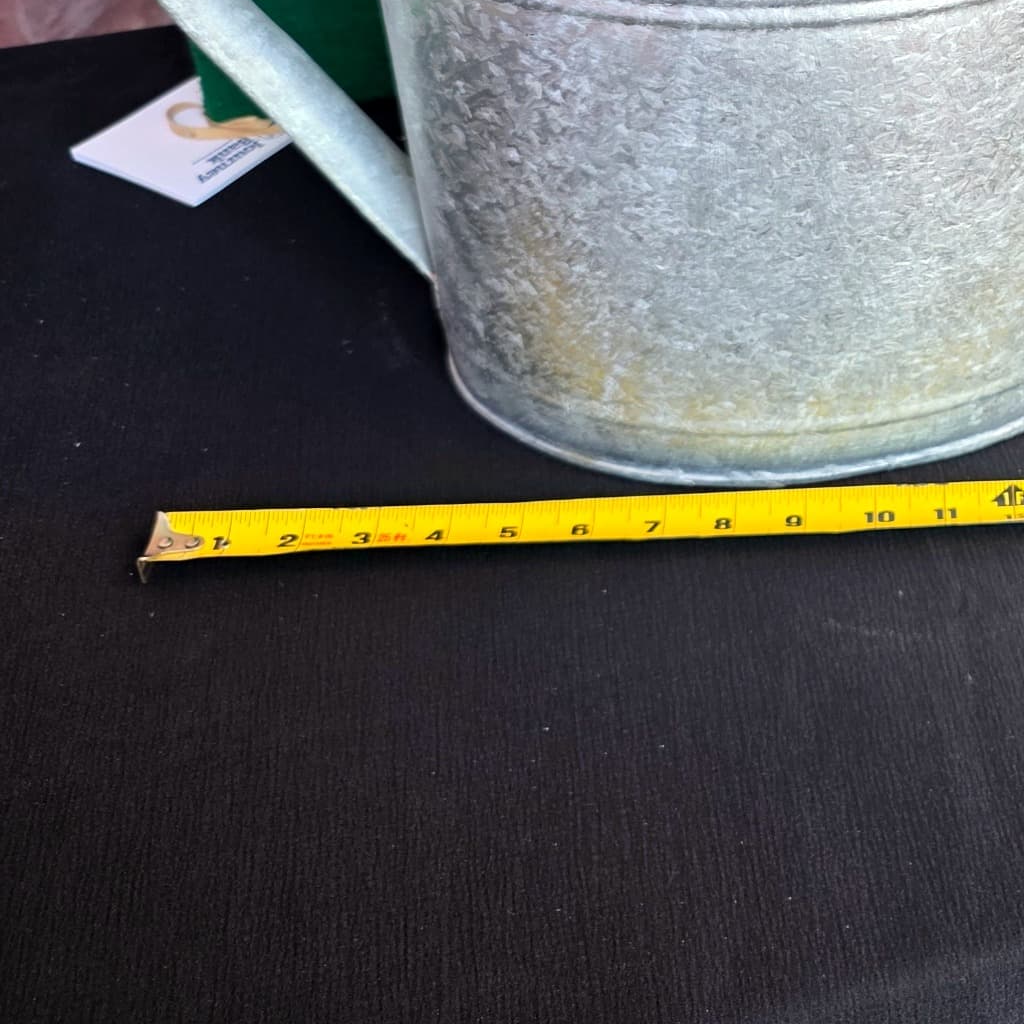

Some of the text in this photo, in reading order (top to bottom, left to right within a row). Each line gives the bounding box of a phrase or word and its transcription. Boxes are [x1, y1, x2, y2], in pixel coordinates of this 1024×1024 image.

[277, 534, 299, 547] 2
[352, 532, 371, 544] 3
[425, 529, 445, 541] 4
[499, 526, 518, 538] 5
[571, 524, 590, 536] 6
[645, 521, 661, 533] 7
[714, 518, 732, 530] 8
[785, 515, 802, 527] 9
[863, 510, 896, 524] 10
[933, 508, 958, 521] 11
